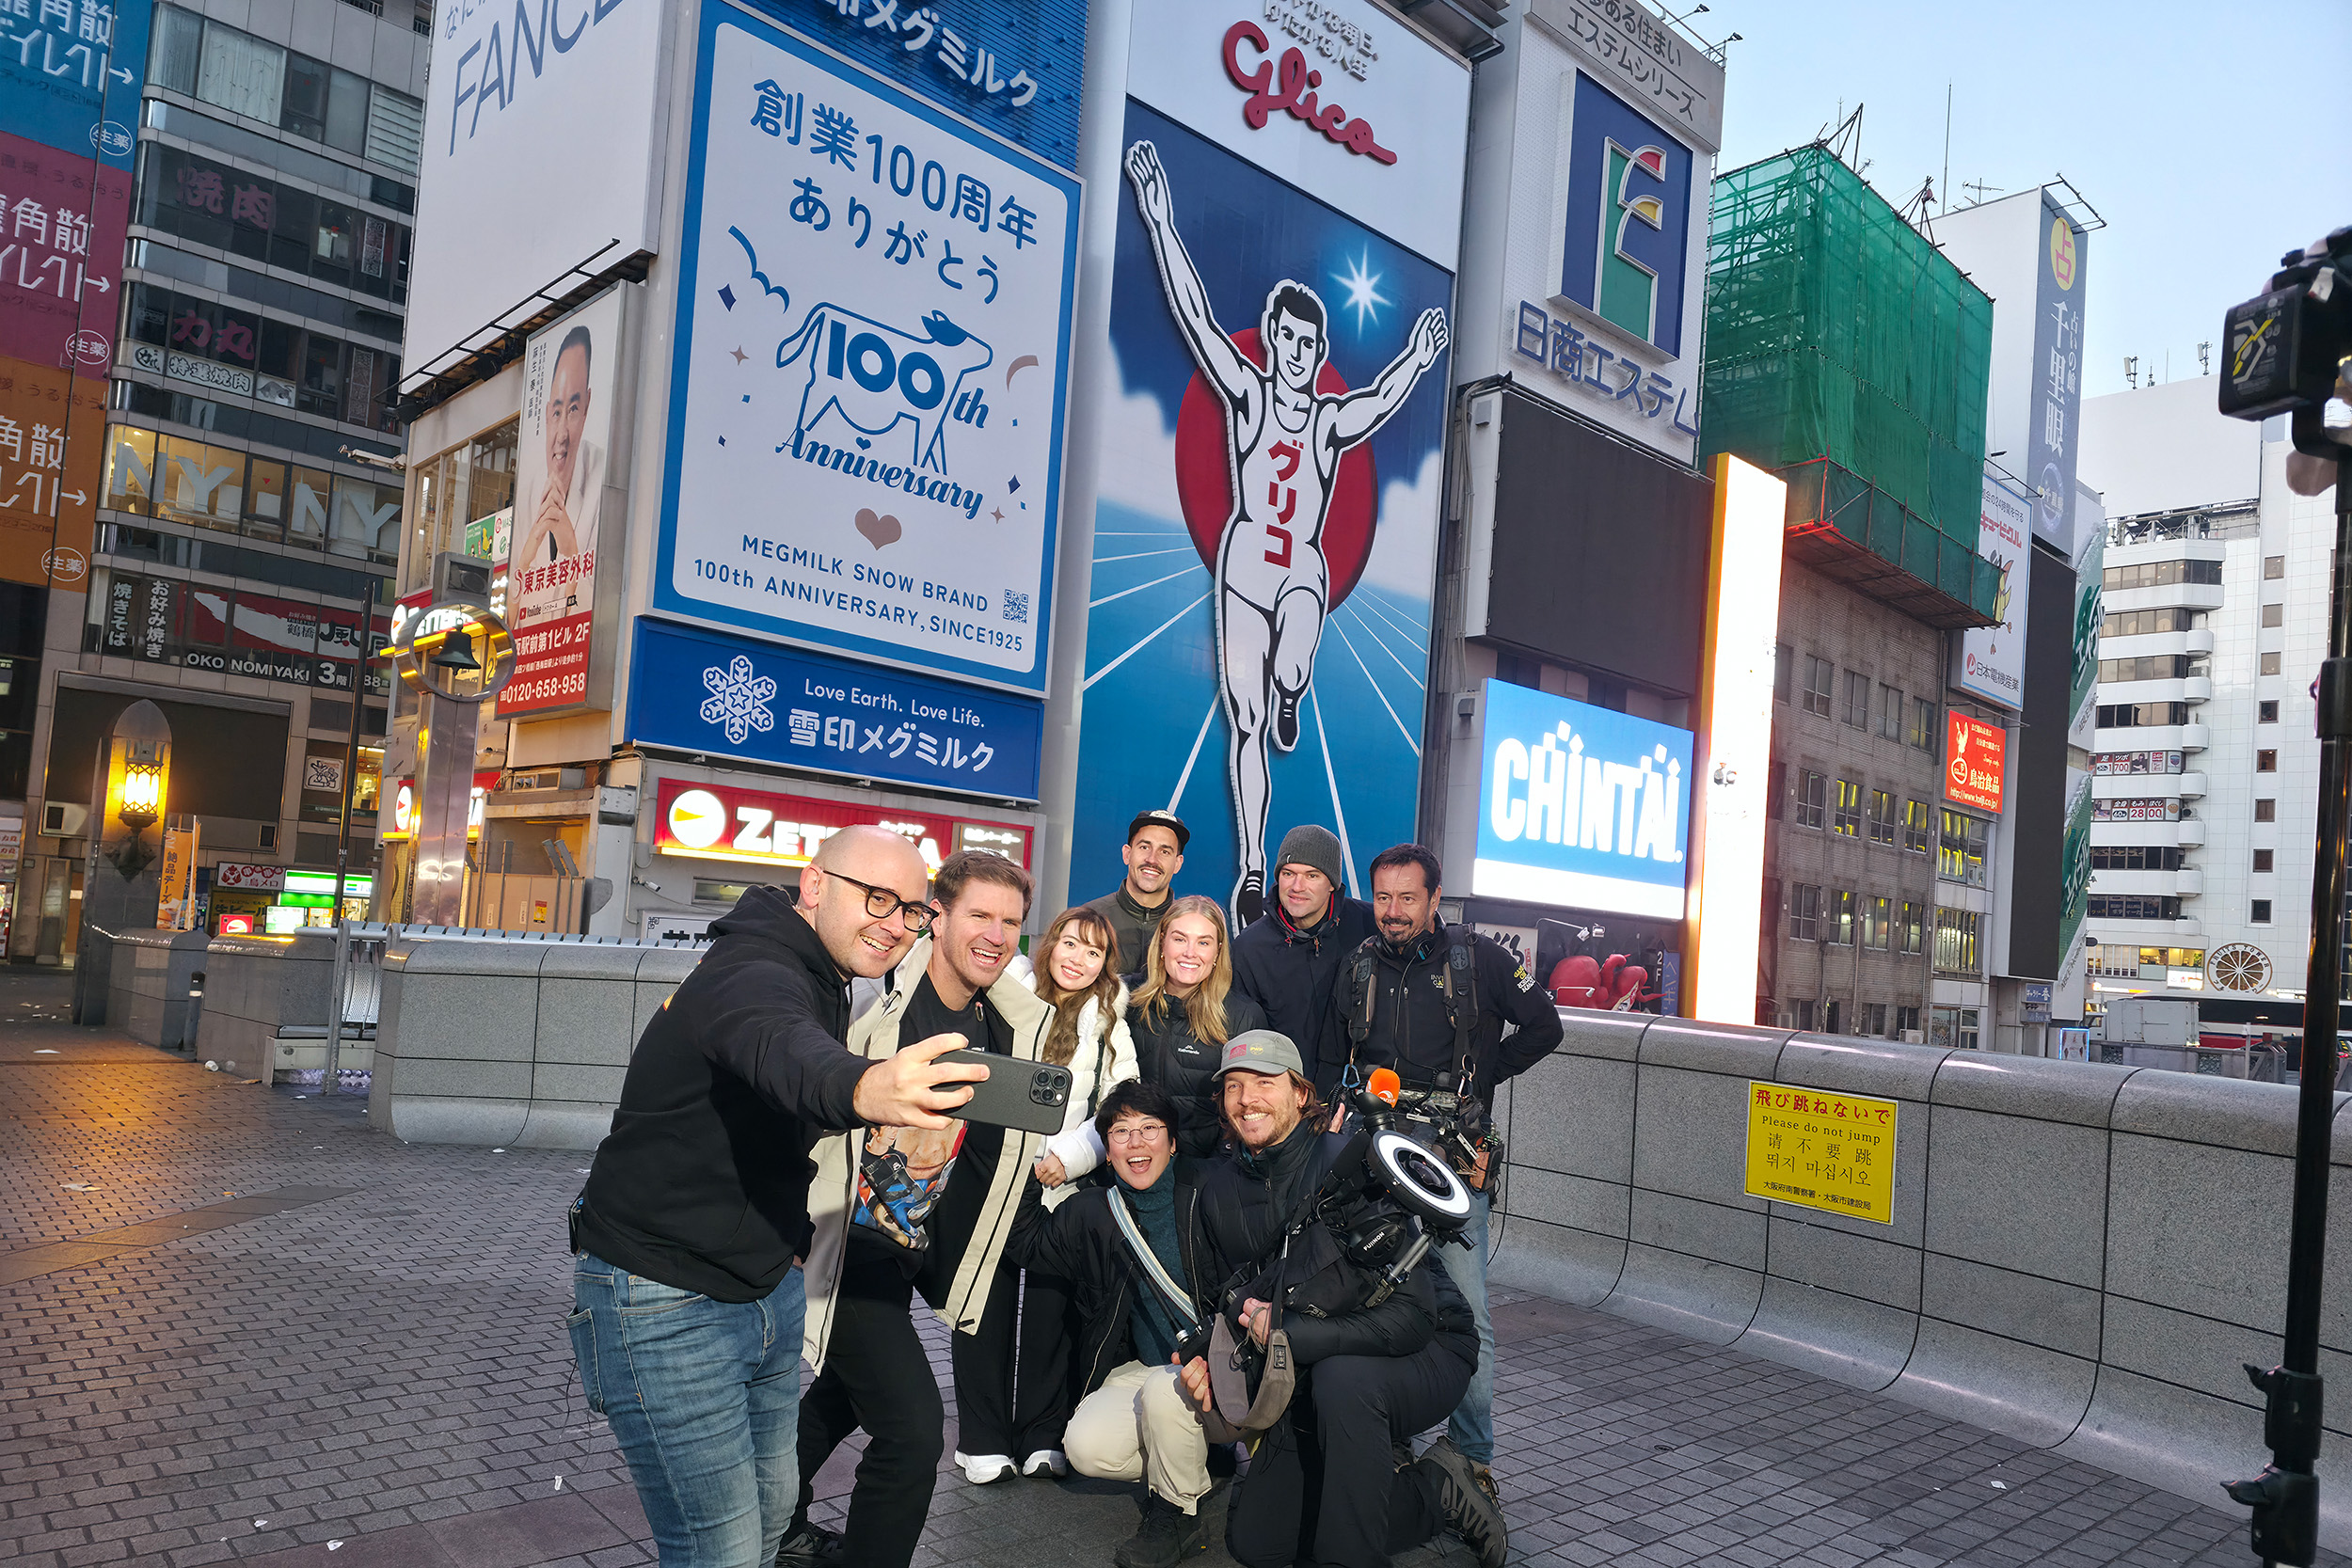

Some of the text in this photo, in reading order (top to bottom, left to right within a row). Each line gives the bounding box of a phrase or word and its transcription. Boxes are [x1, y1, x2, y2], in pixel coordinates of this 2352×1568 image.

[1588, 0, 1681, 67] ある住まい
[1567, 6, 1695, 121] エステムシリーズ
[1223, 20, 1397, 165] Glico
[750, 78, 1038, 250] 創業100周年
[788, 176, 999, 304] ありがとう
[1515, 299, 1700, 438] 日商エステム
[774, 426, 984, 520] Anniversary
[1263, 438, 1305, 569] グリコ
[523, 550, 595, 594] 東京美容外科
[693, 558, 755, 589] 100th
[741, 533, 989, 613] MEGMILK SNOW BRAND
[107, 581, 133, 648] 焼きそば
[146, 579, 170, 658] お好み焼き
[575, 622, 590, 642] 2F
[186, 653, 310, 683] OKO NOMIYAKI
[506, 672, 585, 704] 0120-658-958
[804, 678, 985, 728] Love Earth. Love Life.
[787, 707, 994, 772] 雪印メグミルク
[161, 851, 178, 904] 絶品チーズ
[2210, 943, 2270, 968] FRUITS TOWER
[1756, 1089, 1891, 1125] 飛び跳ねないで
[1762, 1115, 1881, 1147] Please do not jump
[1766, 1152, 1871, 1187] 뛰지 마십시오
[1768, 1132, 1872, 1166] 请不要跳
[1362, 1231, 1386, 1252] FUJINON
